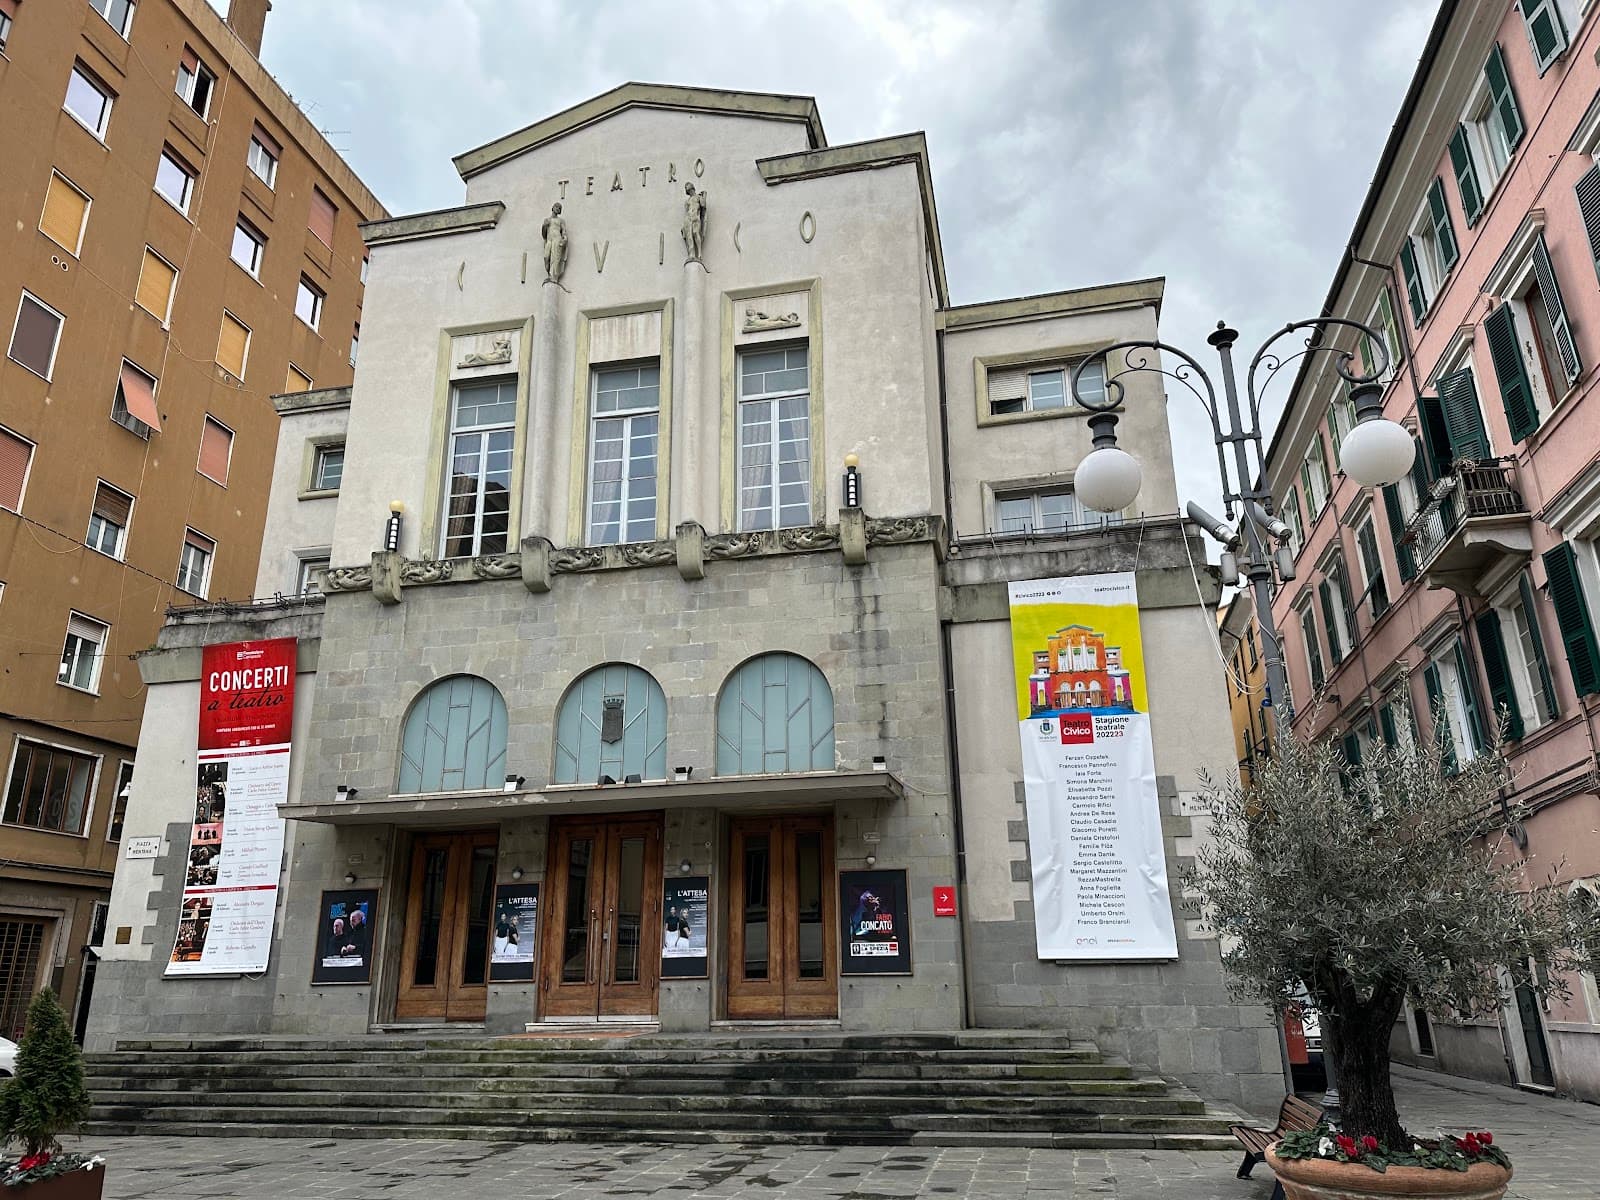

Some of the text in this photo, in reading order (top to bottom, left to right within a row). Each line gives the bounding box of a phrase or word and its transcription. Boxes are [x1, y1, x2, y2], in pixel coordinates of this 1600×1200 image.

[558, 157, 705, 200] TEATRO
[457, 209, 817, 292] CIVICO
[209, 665, 288, 692] CONCERTI
[207, 683, 285, 711] a teatro
[1063, 720, 1090, 728] Teatro
[1095, 717, 1130, 725] Stagione
[1063, 726, 1091, 736] Civico
[677, 889, 708, 897] L'ATTESA
[508, 896, 538, 905] L'ATTESA
[860, 920, 893, 931] CONCATO
